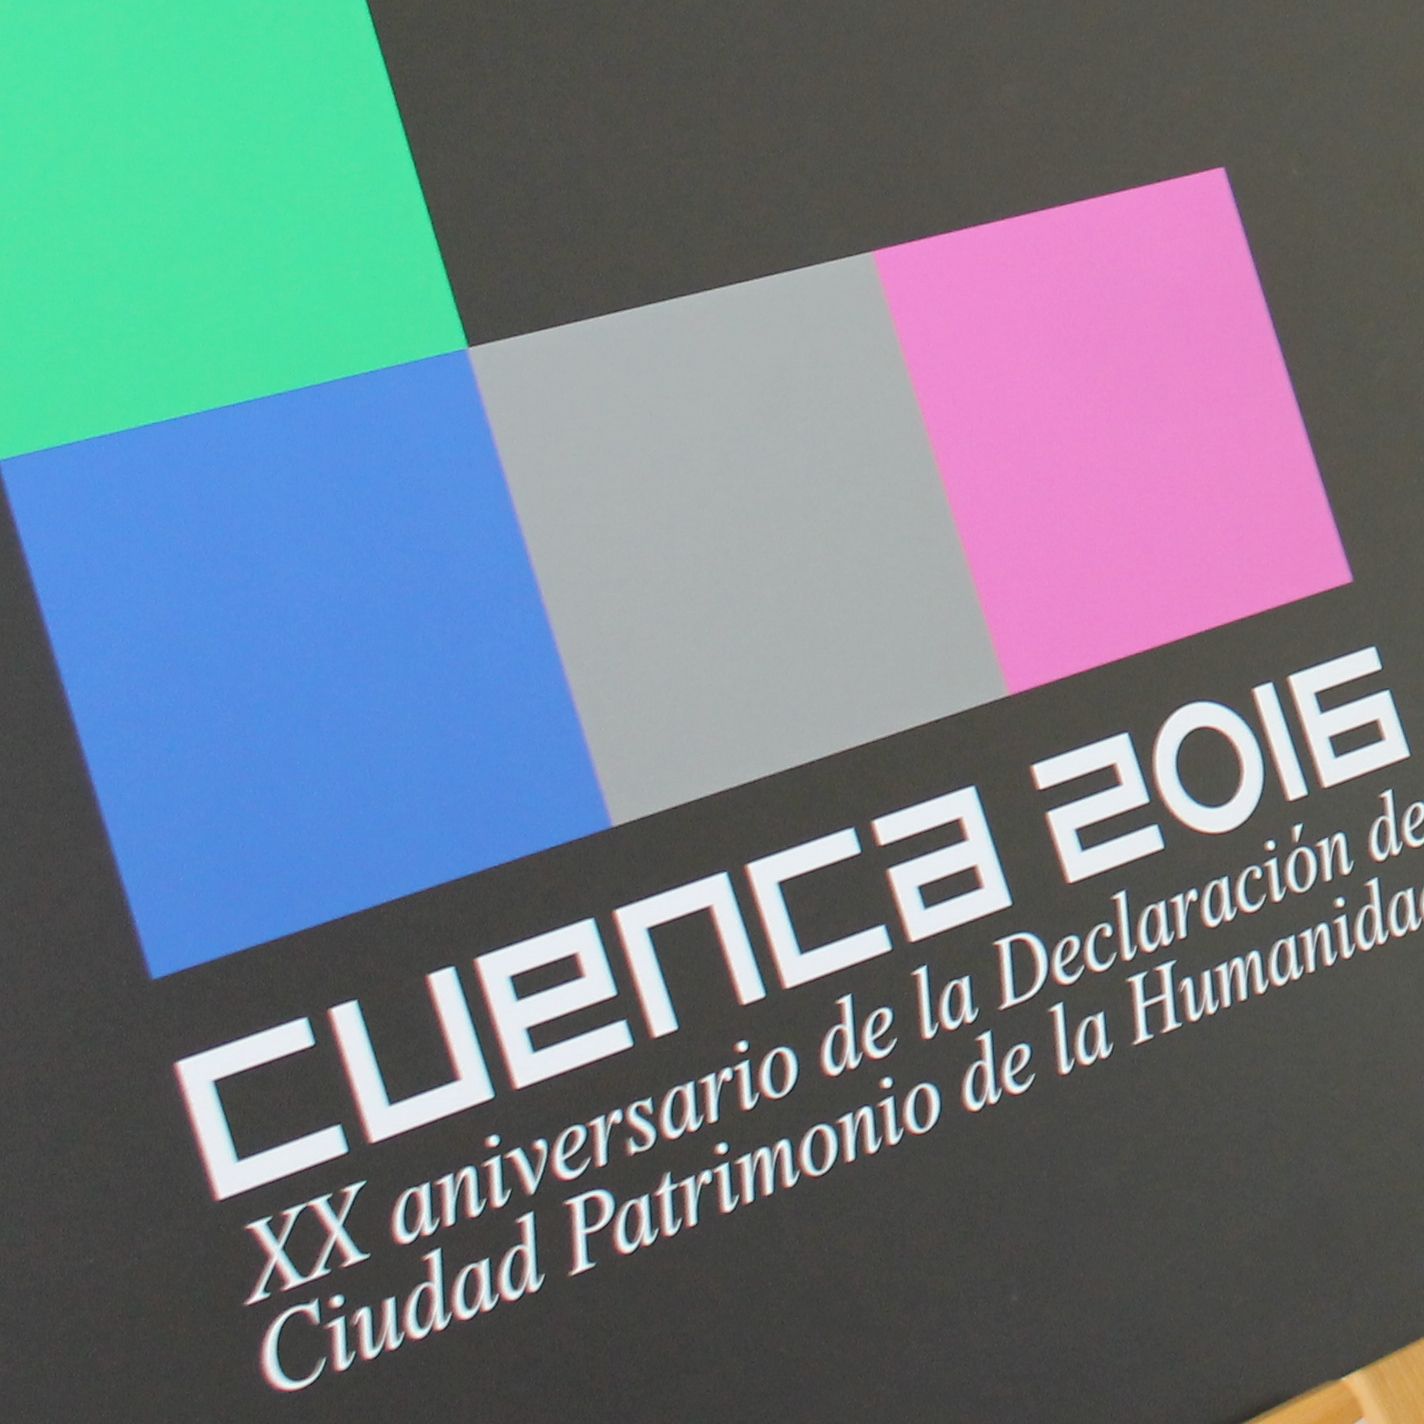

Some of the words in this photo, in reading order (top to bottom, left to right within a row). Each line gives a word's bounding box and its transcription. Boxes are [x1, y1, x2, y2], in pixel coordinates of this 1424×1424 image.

[1030, 645, 1412, 884] 2016
[242, 1180, 371, 1307] XX
[389, 1039, 800, 1245] aniversario
[818, 993, 898, 1077] de
[910, 964, 980, 1040] la
[992, 822, 1355, 1011] Declaración
[258, 1210, 547, 1393] Ciudad
[561, 1076, 943, 1278] Patrimonio
[959, 1029, 1037, 1113] de
[1047, 1001, 1115, 1077] la
